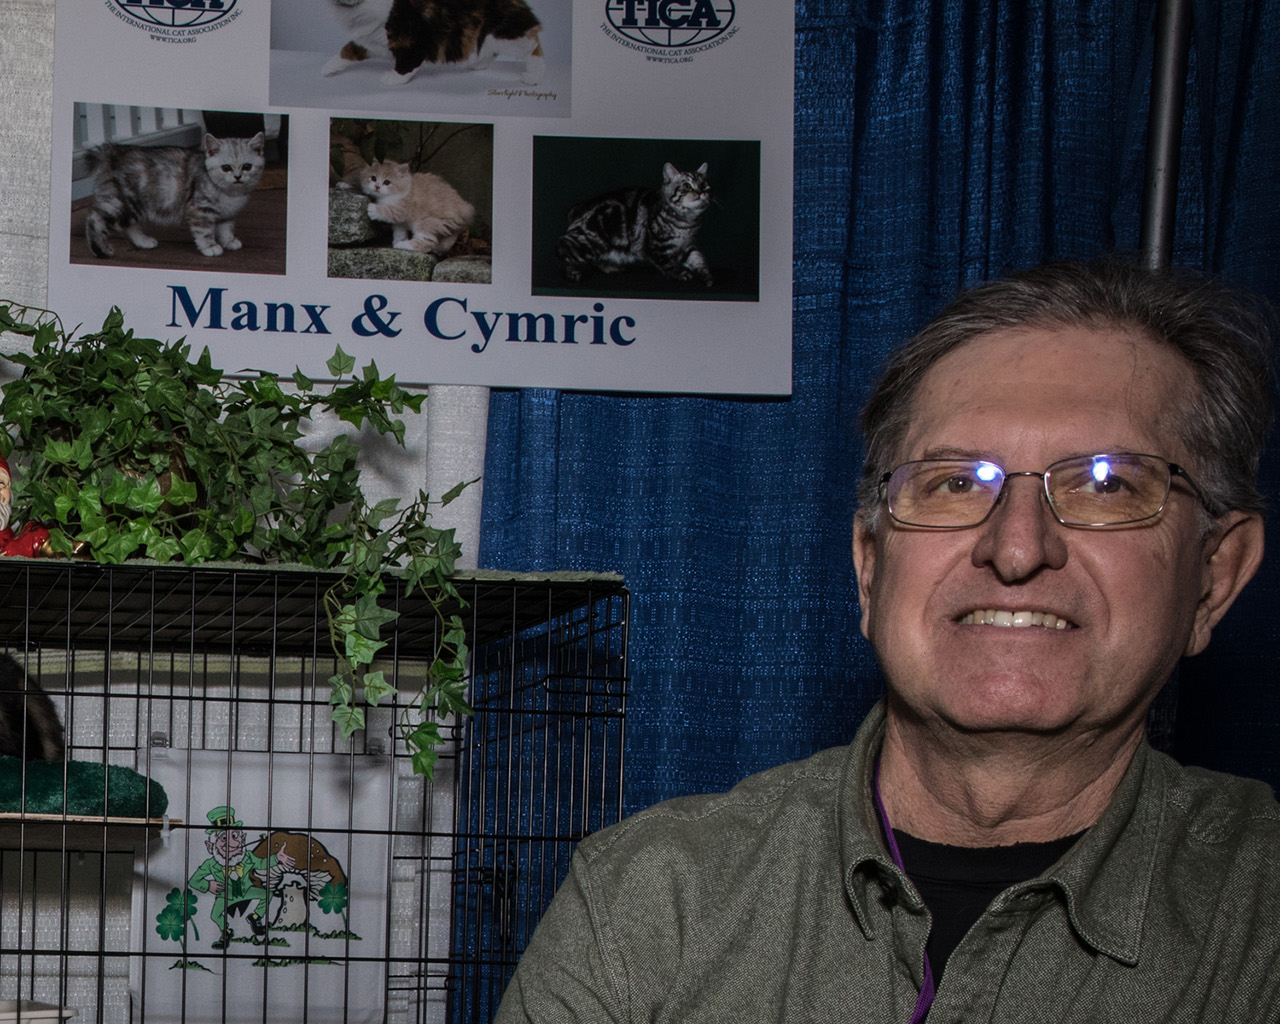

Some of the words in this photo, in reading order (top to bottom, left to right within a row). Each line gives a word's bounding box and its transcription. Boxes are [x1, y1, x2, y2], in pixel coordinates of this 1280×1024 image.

[104, 0, 116, 14] THE
[115, 11, 171, 36] INTERNATIONAL
[172, 29, 187, 37] CAT
[187, 16, 232, 36] ASSOCIATION
[616, 0, 722, 27] TICA
[600, 22, 611, 37] THE
[610, 33, 668, 56] INTERNATIONAL
[684, 35, 729, 55] ASSOCIATION
[166, 285, 332, 335] Manx
[351, 294, 403, 338] &
[422, 297, 637, 353] Cymric
